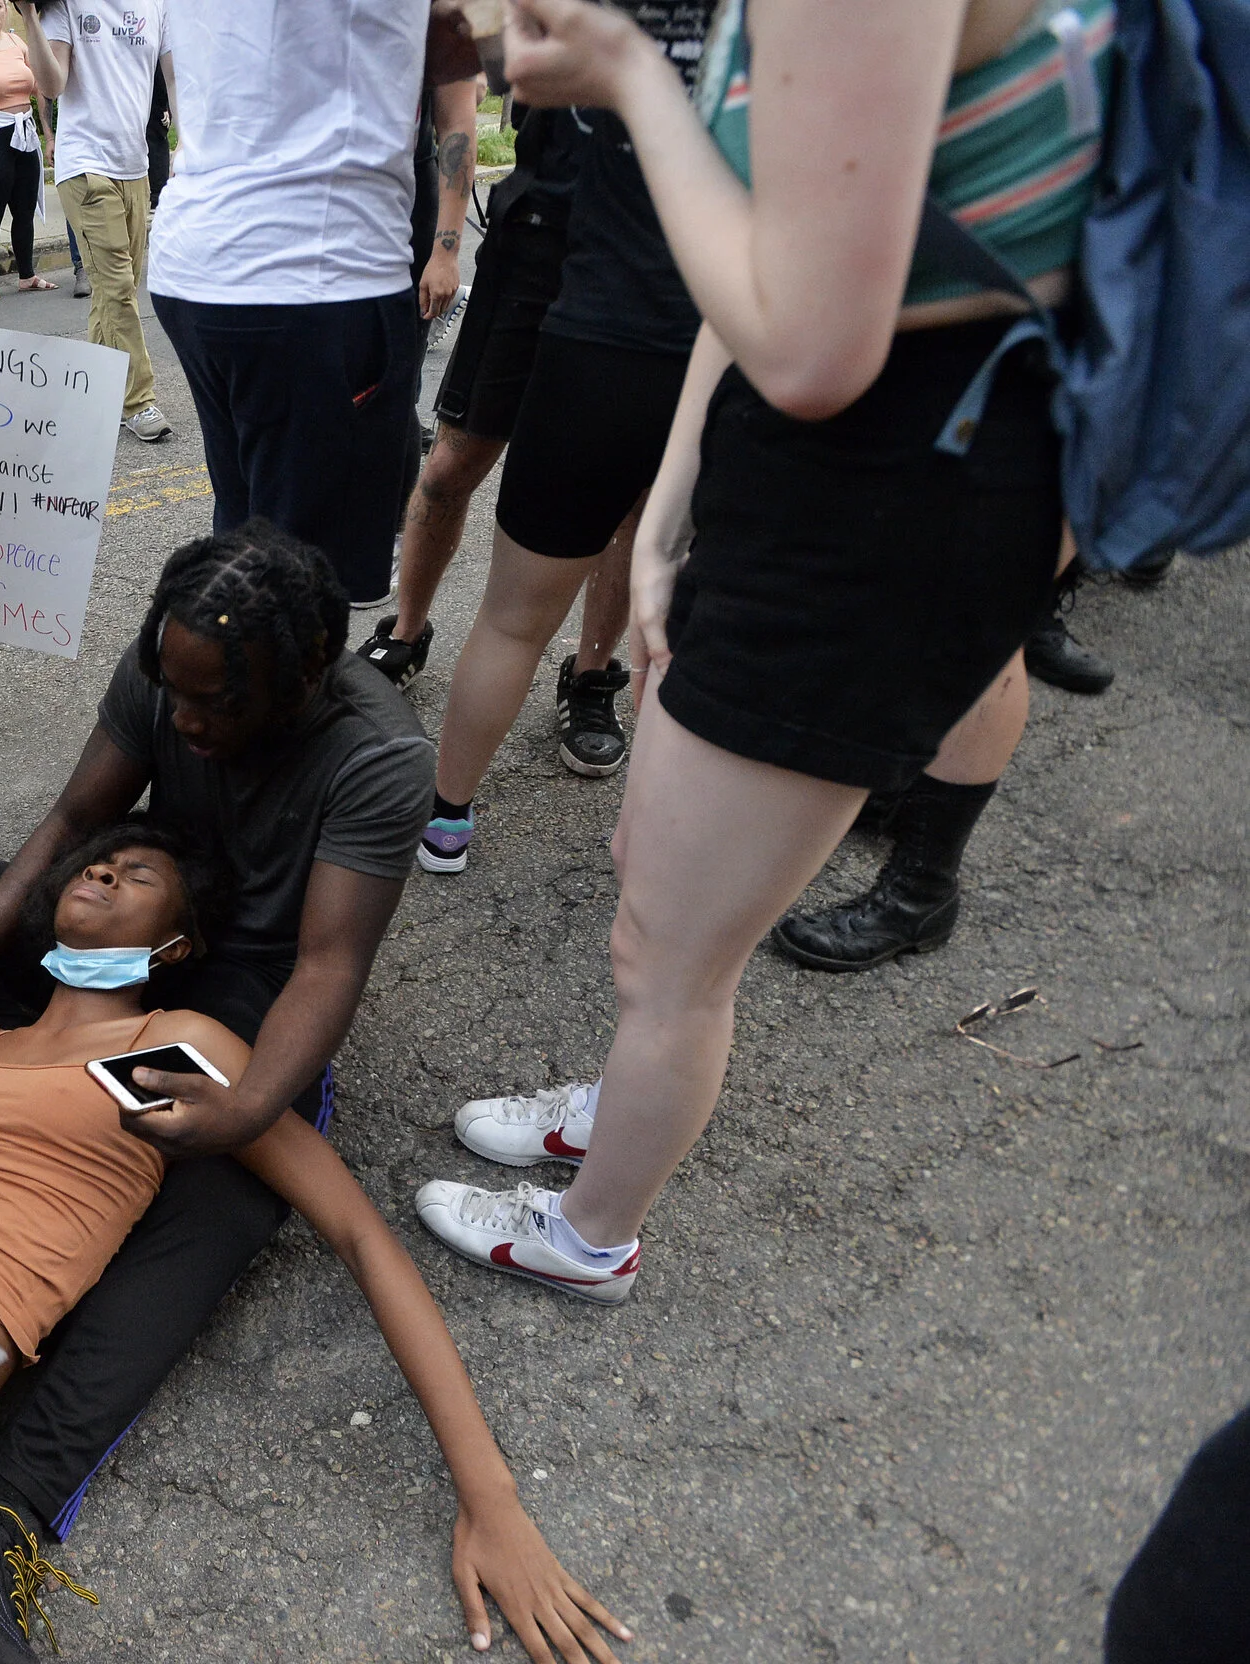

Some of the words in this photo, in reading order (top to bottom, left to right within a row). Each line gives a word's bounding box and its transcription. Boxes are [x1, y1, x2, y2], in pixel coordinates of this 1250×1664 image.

[112, 27, 134, 36] LIVE
[128, 36, 147, 46] TRI
[65, 363, 89, 394] in
[24, 419, 57, 437] we
